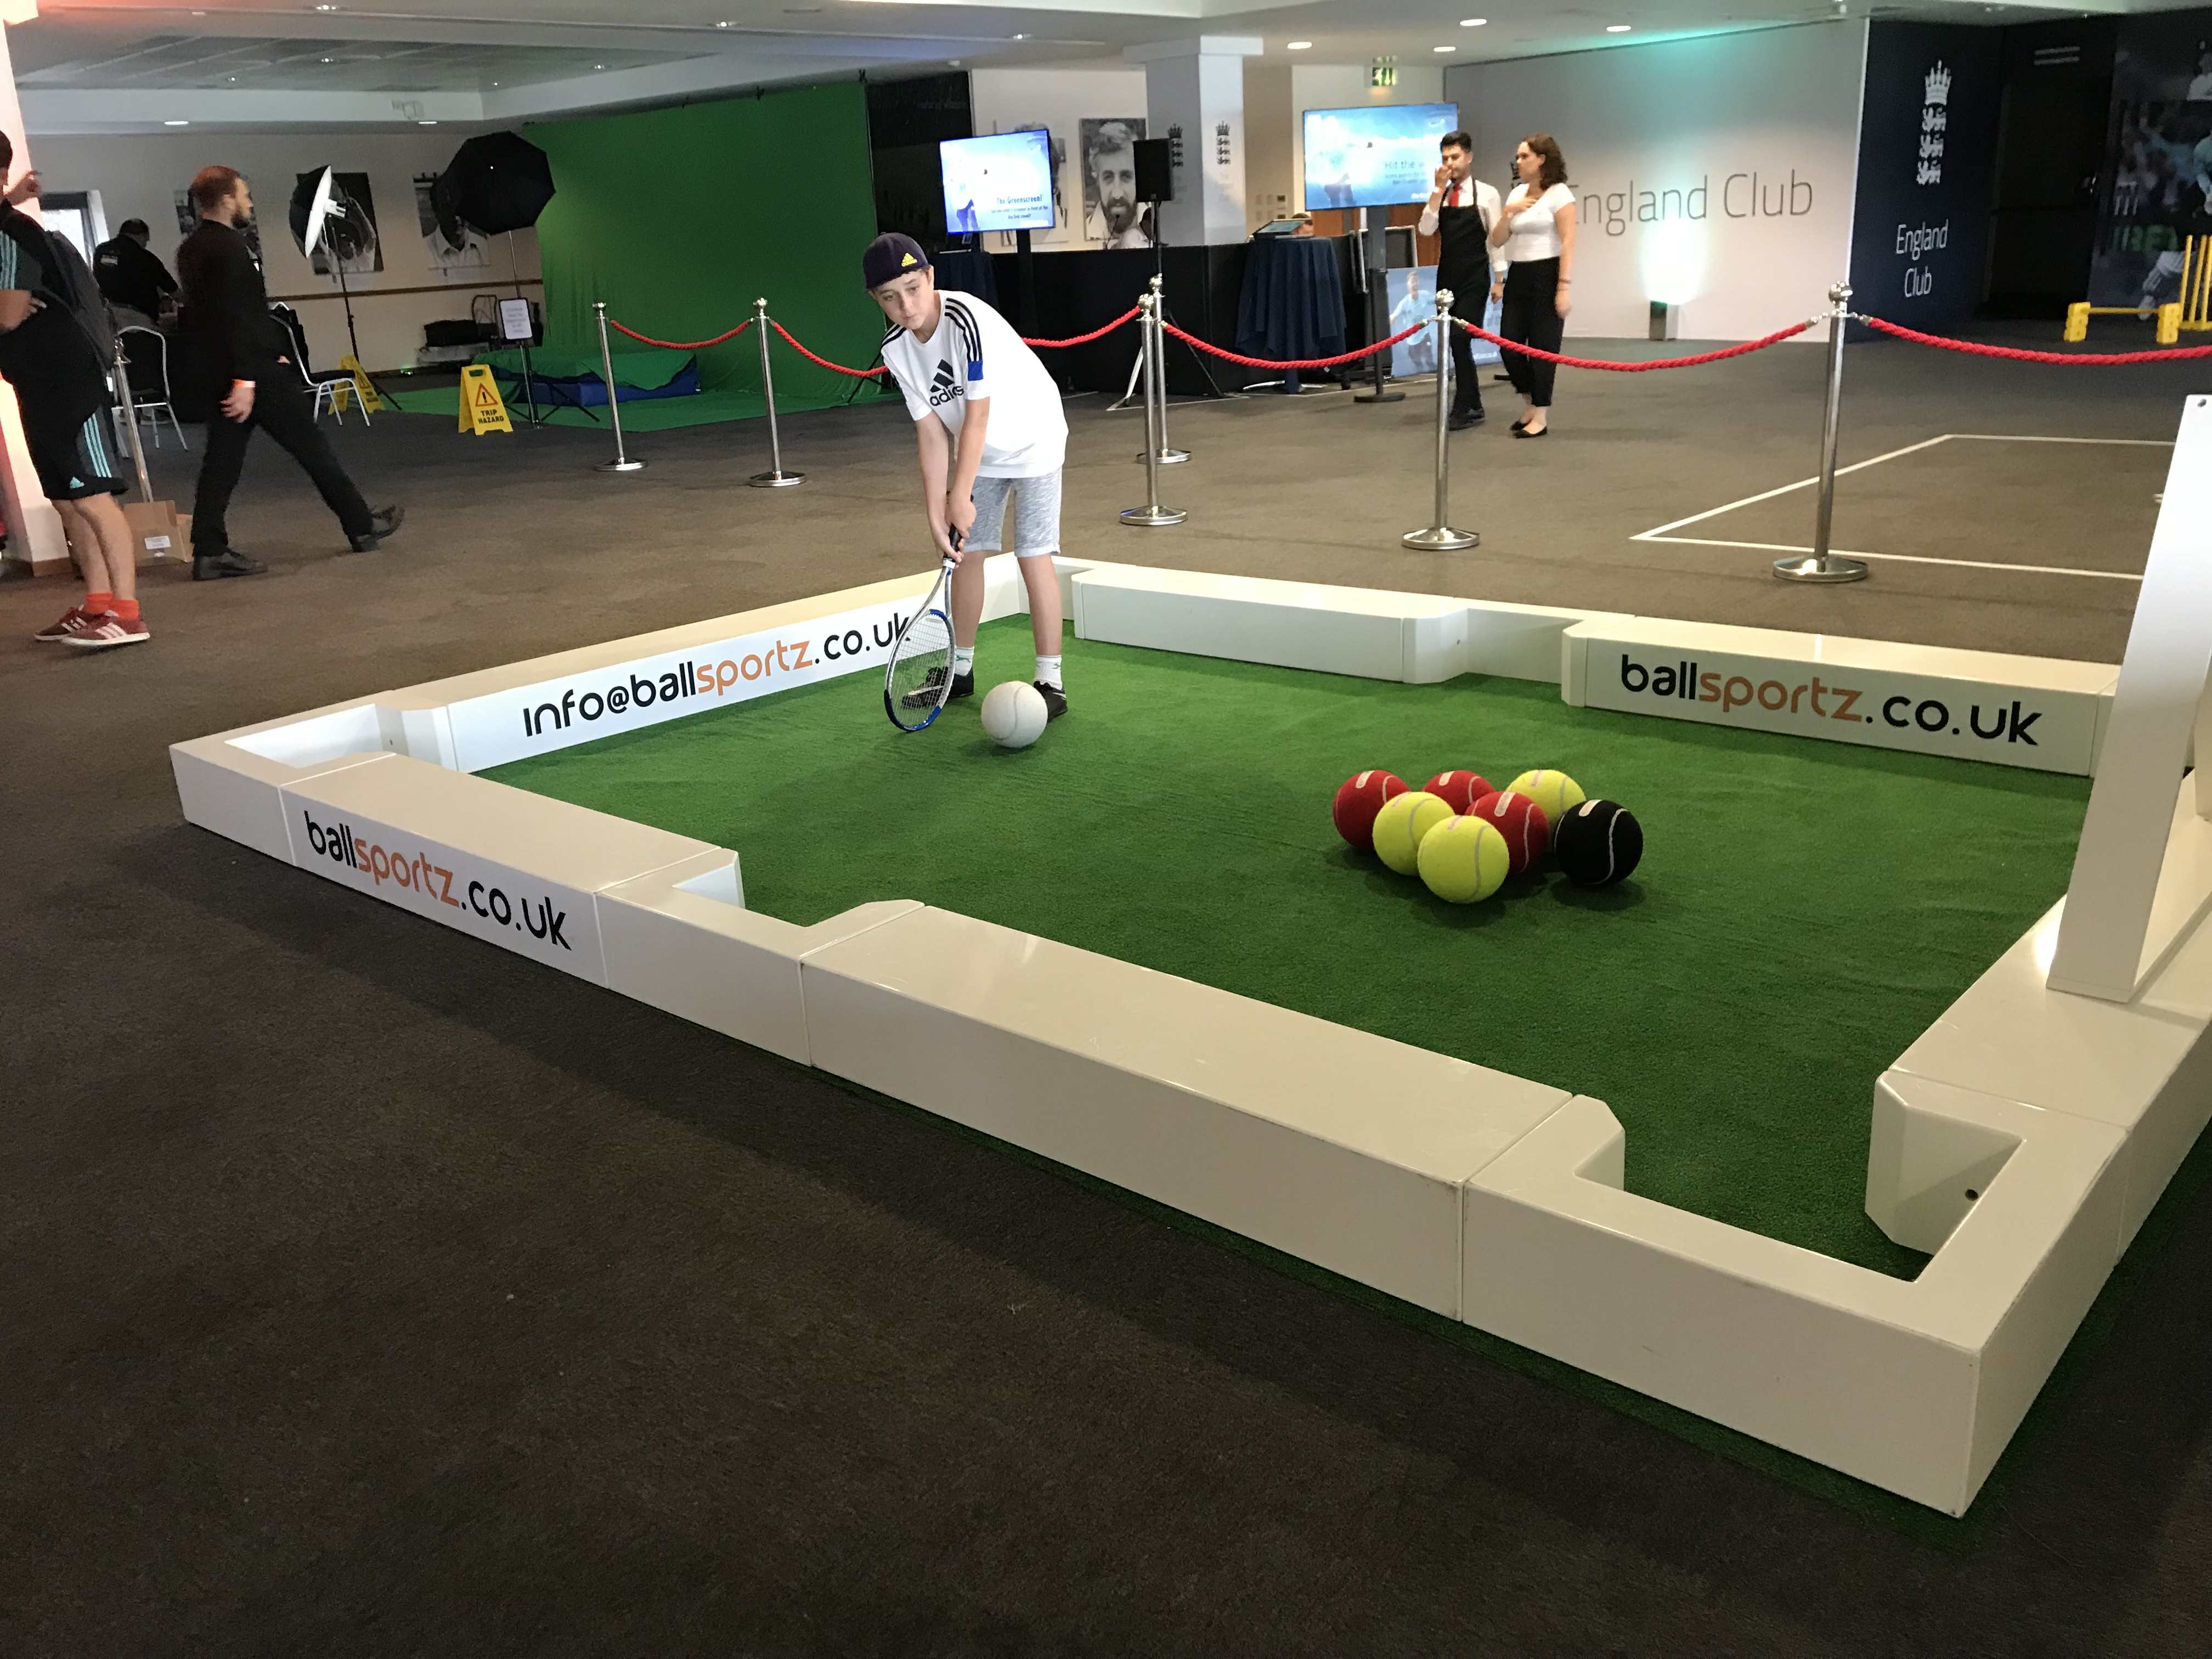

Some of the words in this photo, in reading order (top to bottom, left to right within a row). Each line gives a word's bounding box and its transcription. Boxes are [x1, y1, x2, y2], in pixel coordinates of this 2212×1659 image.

[1724, 169, 1813, 218] Club
[1896, 218, 1949, 261] England
[1904, 265, 1932, 297] Club
[478, 416, 504, 424] HAZARD
[1621, 653, 2042, 746] ballsportz.co.uk
[304, 810, 572, 951] ballsportz.co.uk
